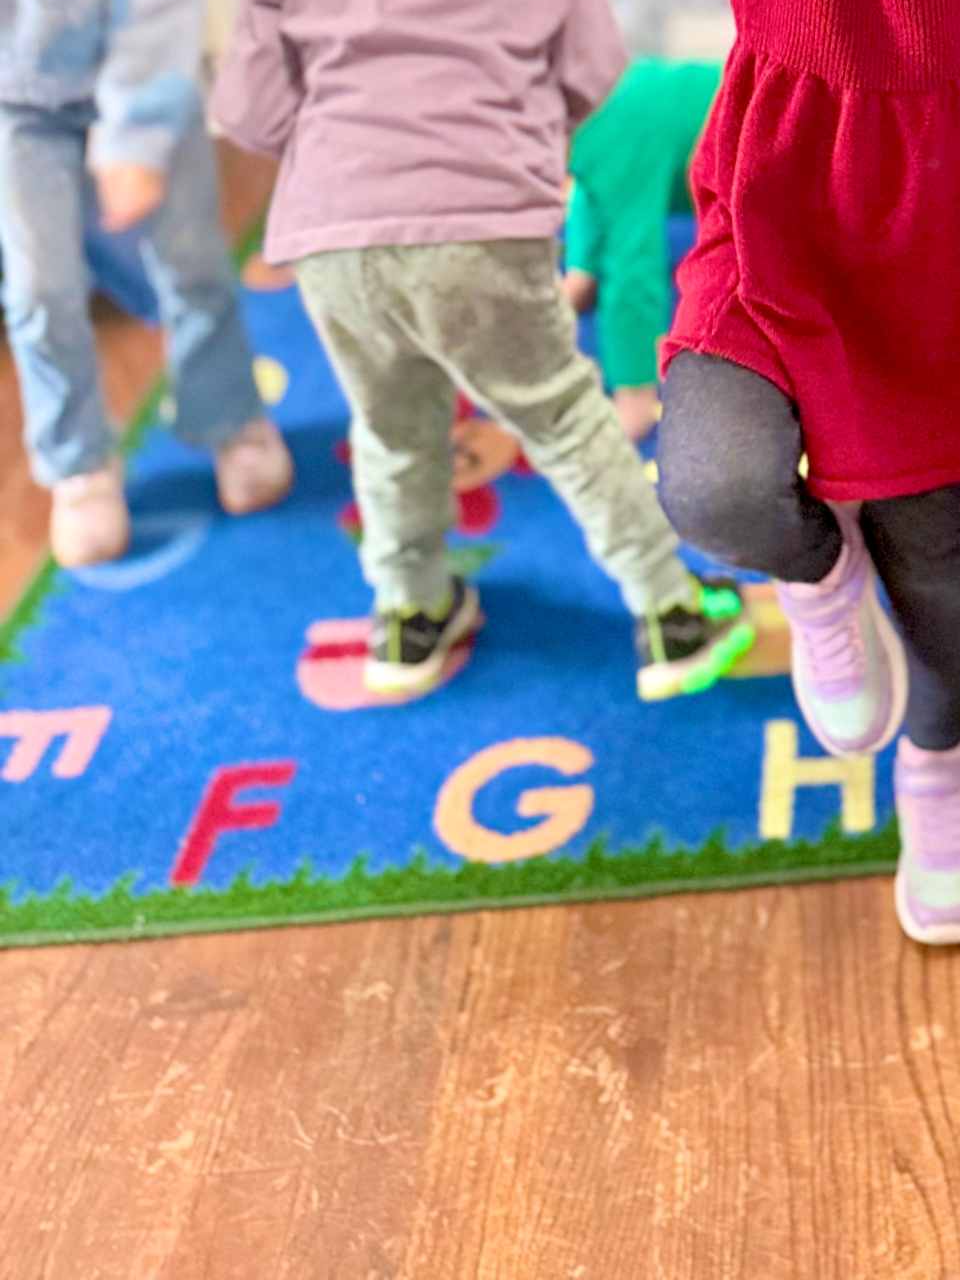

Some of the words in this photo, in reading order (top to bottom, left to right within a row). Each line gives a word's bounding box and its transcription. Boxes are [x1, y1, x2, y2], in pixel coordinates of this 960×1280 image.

[170, 760, 297, 888] F
[433, 736, 595, 862] G
[759, 718, 876, 840] H
